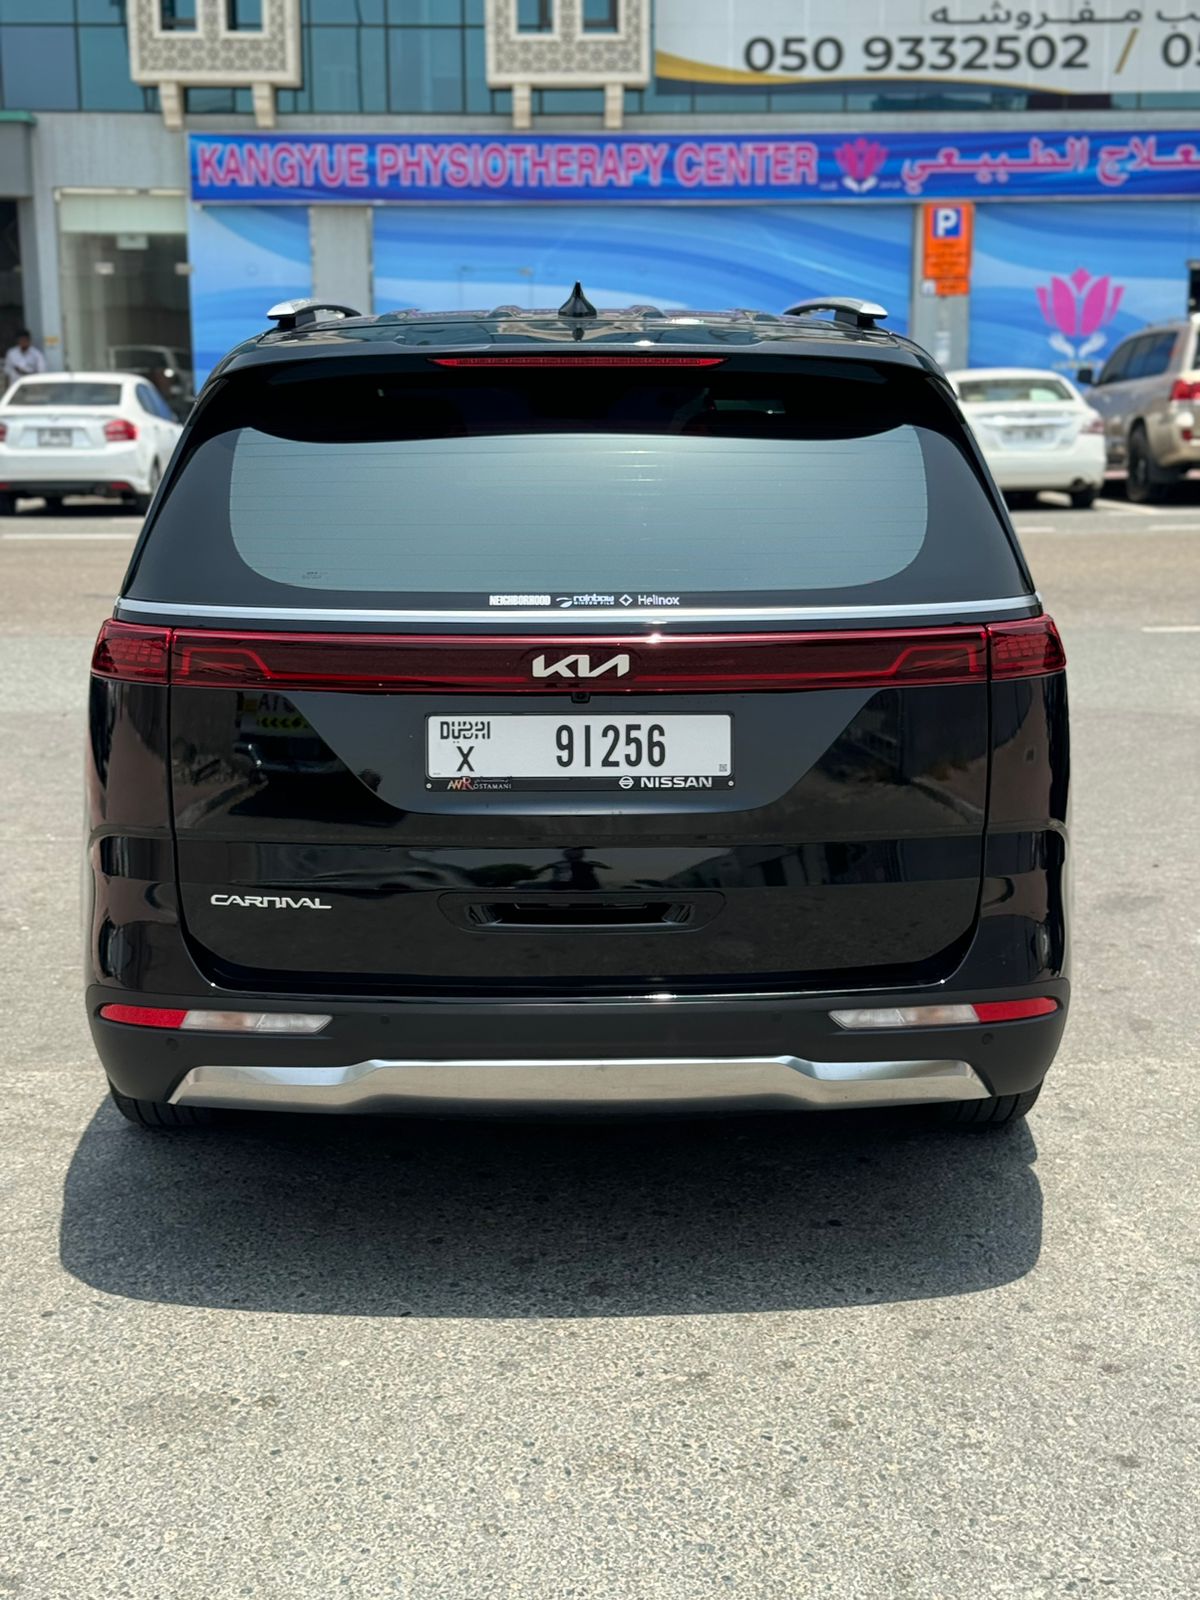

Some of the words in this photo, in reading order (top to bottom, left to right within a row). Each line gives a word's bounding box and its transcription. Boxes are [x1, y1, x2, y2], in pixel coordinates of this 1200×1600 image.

[744, 37, 844, 72] 050
[863, 35, 1089, 71] 9332502
[197, 143, 369, 188] KANGYUE
[375, 142, 670, 188] PHYSIOTHERAPY
[673, 142, 819, 187] CENTER
[902, 136, 1090, 194] الطبيعي
[936, 208, 958, 236] P
[638, 594, 680, 606] Helinox
[456, 746, 475, 772] X
[555, 724, 666, 768] 91256
[640, 777, 712, 788] NISSAN
[210, 894, 332, 909] CARNIVAL
